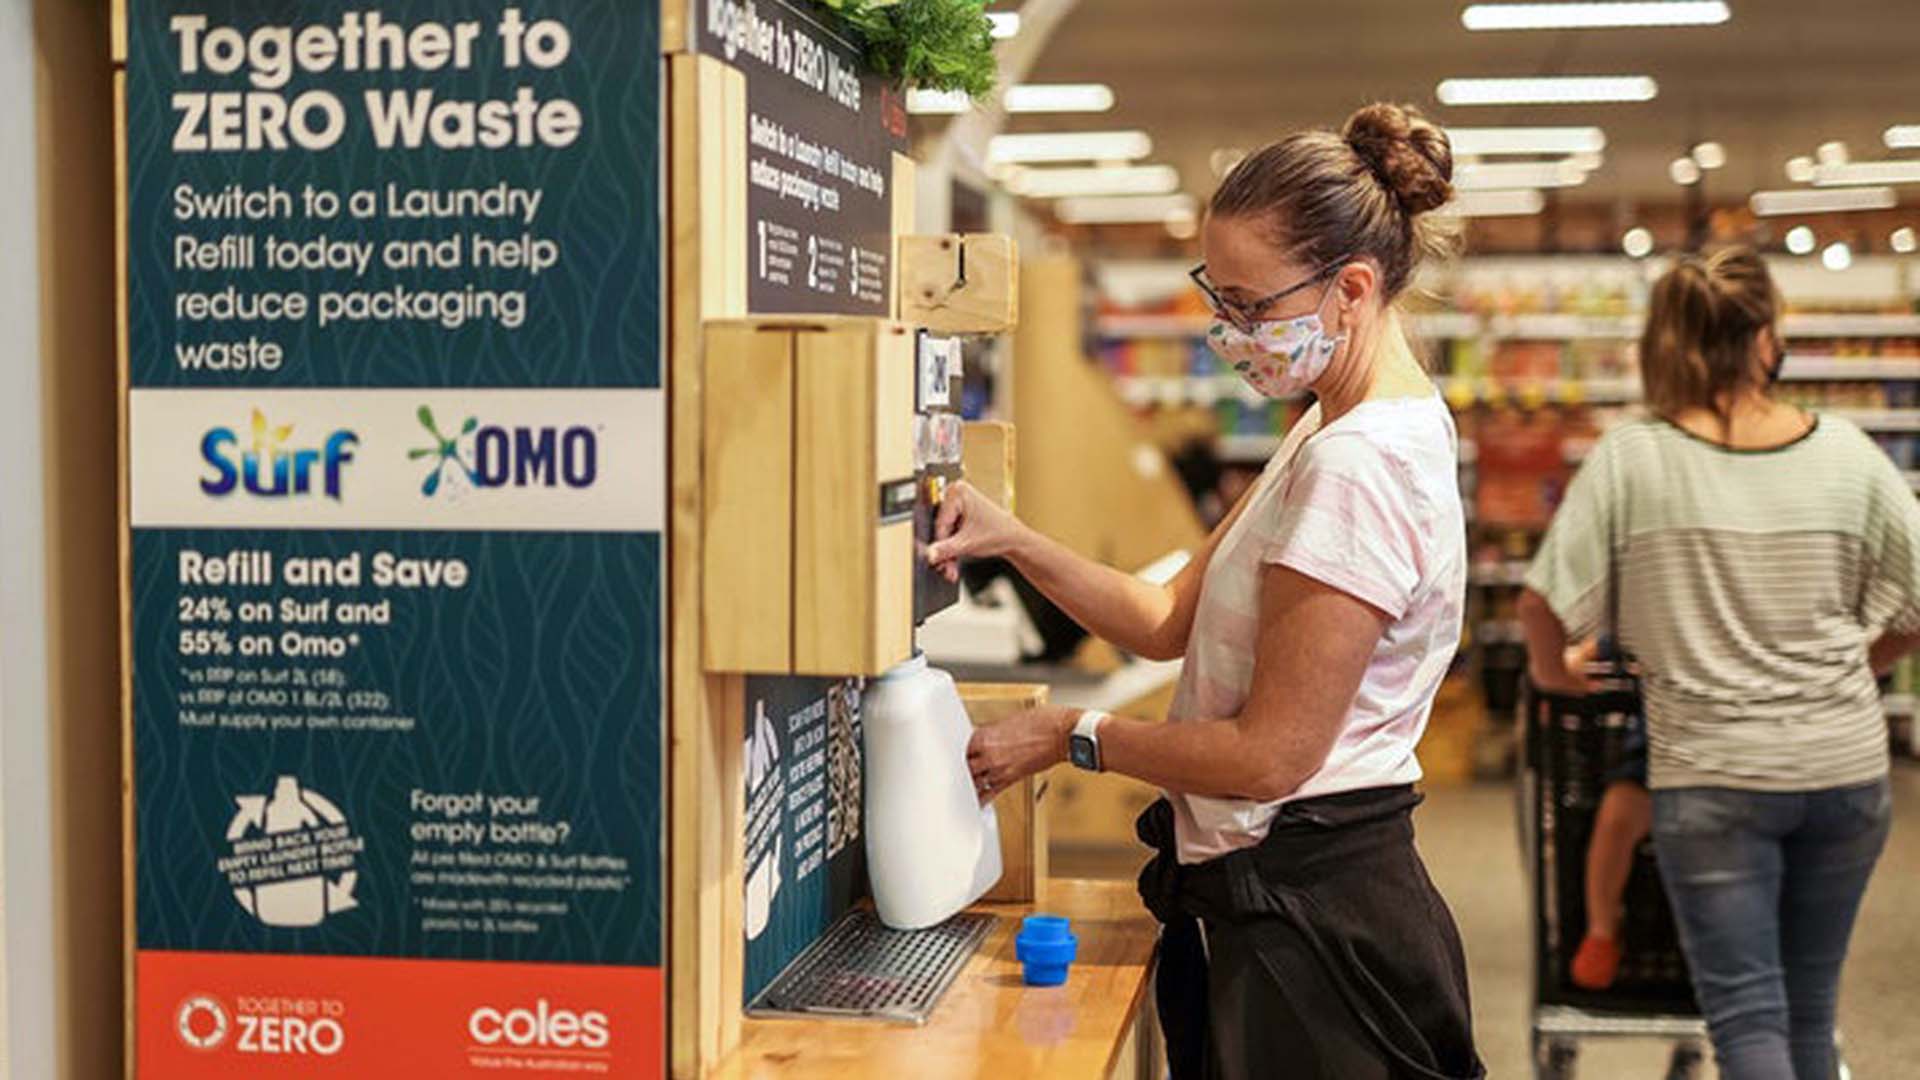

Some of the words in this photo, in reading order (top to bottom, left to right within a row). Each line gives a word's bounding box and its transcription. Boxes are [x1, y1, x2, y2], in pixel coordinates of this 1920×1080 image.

[169, 11, 479, 90] Together
[498, 8, 571, 69] to
[708, 0, 774, 64] Together
[776, 20, 792, 74] to
[794, 30, 826, 92] ZERO
[827, 51, 861, 112] Waste
[170, 89, 347, 152] ZERO
[366, 87, 582, 149] Waste
[174, 184, 291, 220] Switch
[304, 186, 340, 219] to
[349, 191, 376, 217] a
[387, 183, 543, 223] Laundry
[175, 236, 254, 270] Refill
[266, 235, 373, 275] today
[383, 234, 461, 269] and
[472, 233, 558, 274] help
[758, 220, 766, 278] 1
[808, 235, 817, 287] 2
[175, 286, 307, 321] reduce
[318, 284, 526, 328] packaging
[175, 338, 283, 370] waste
[199, 425, 359, 503] Surf
[475, 425, 596, 488] OMO
[179, 551, 271, 586] Refill
[283, 552, 361, 586] and
[371, 552, 469, 588] Save
[179, 597, 232, 622] 24%
[238, 602, 273, 622] on
[280, 598, 330, 623] Surf
[335, 600, 390, 624] and
[179, 630, 232, 655] 55%
[238, 635, 273, 655] on
[260, 667, 289, 685] Surf
[246, 690, 288, 706] OMO
[179, 711, 215, 727] Must
[219, 713, 268, 731] supply
[270, 715, 304, 731] your
[306, 717, 341, 729] own
[342, 715, 415, 730] container
[410, 788, 483, 817] Forgot
[489, 796, 540, 817] your
[410, 821, 485, 845] empty
[490, 821, 570, 845] bottle?
[411, 850, 429, 864] All
[494, 852, 532, 867] OMO
[536, 854, 547, 867] &
[550, 854, 578, 868] Surf
[579, 854, 628, 870] Bottles
[512, 872, 573, 889] recycled
[237, 996, 317, 1015] TOGETHER
[322, 999, 344, 1017] TO
[468, 999, 609, 1048] coles
[236, 1016, 344, 1055] ZERO
